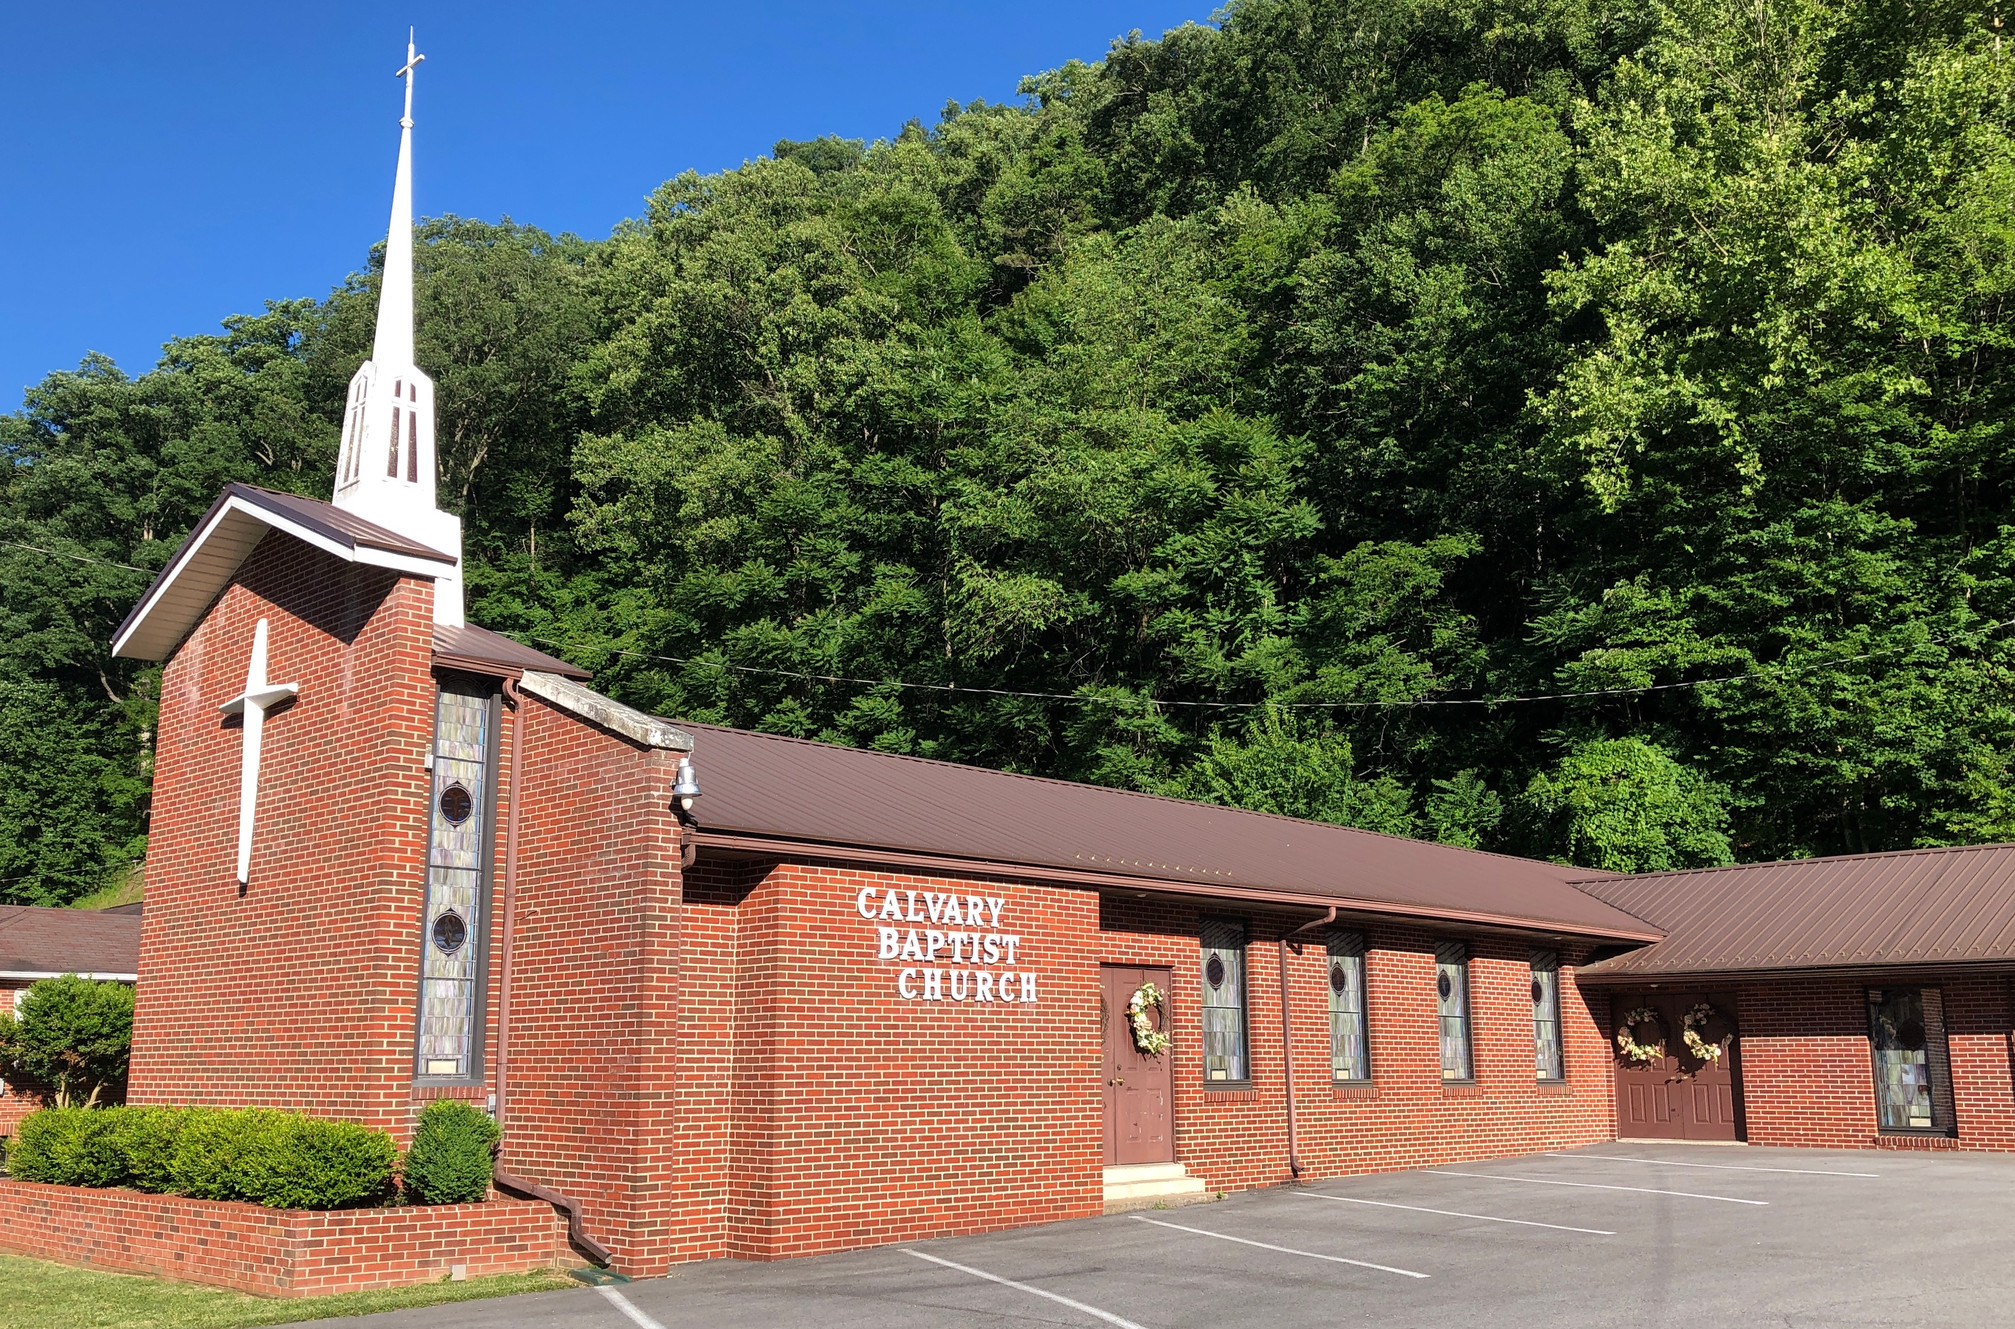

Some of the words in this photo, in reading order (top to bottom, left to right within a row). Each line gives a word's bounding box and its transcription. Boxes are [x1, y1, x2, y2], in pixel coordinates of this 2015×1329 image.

[857, 888, 1005, 928] CALVARY
[877, 926, 1020, 965] BAPTIST
[898, 968, 1038, 1003] CHURCH
